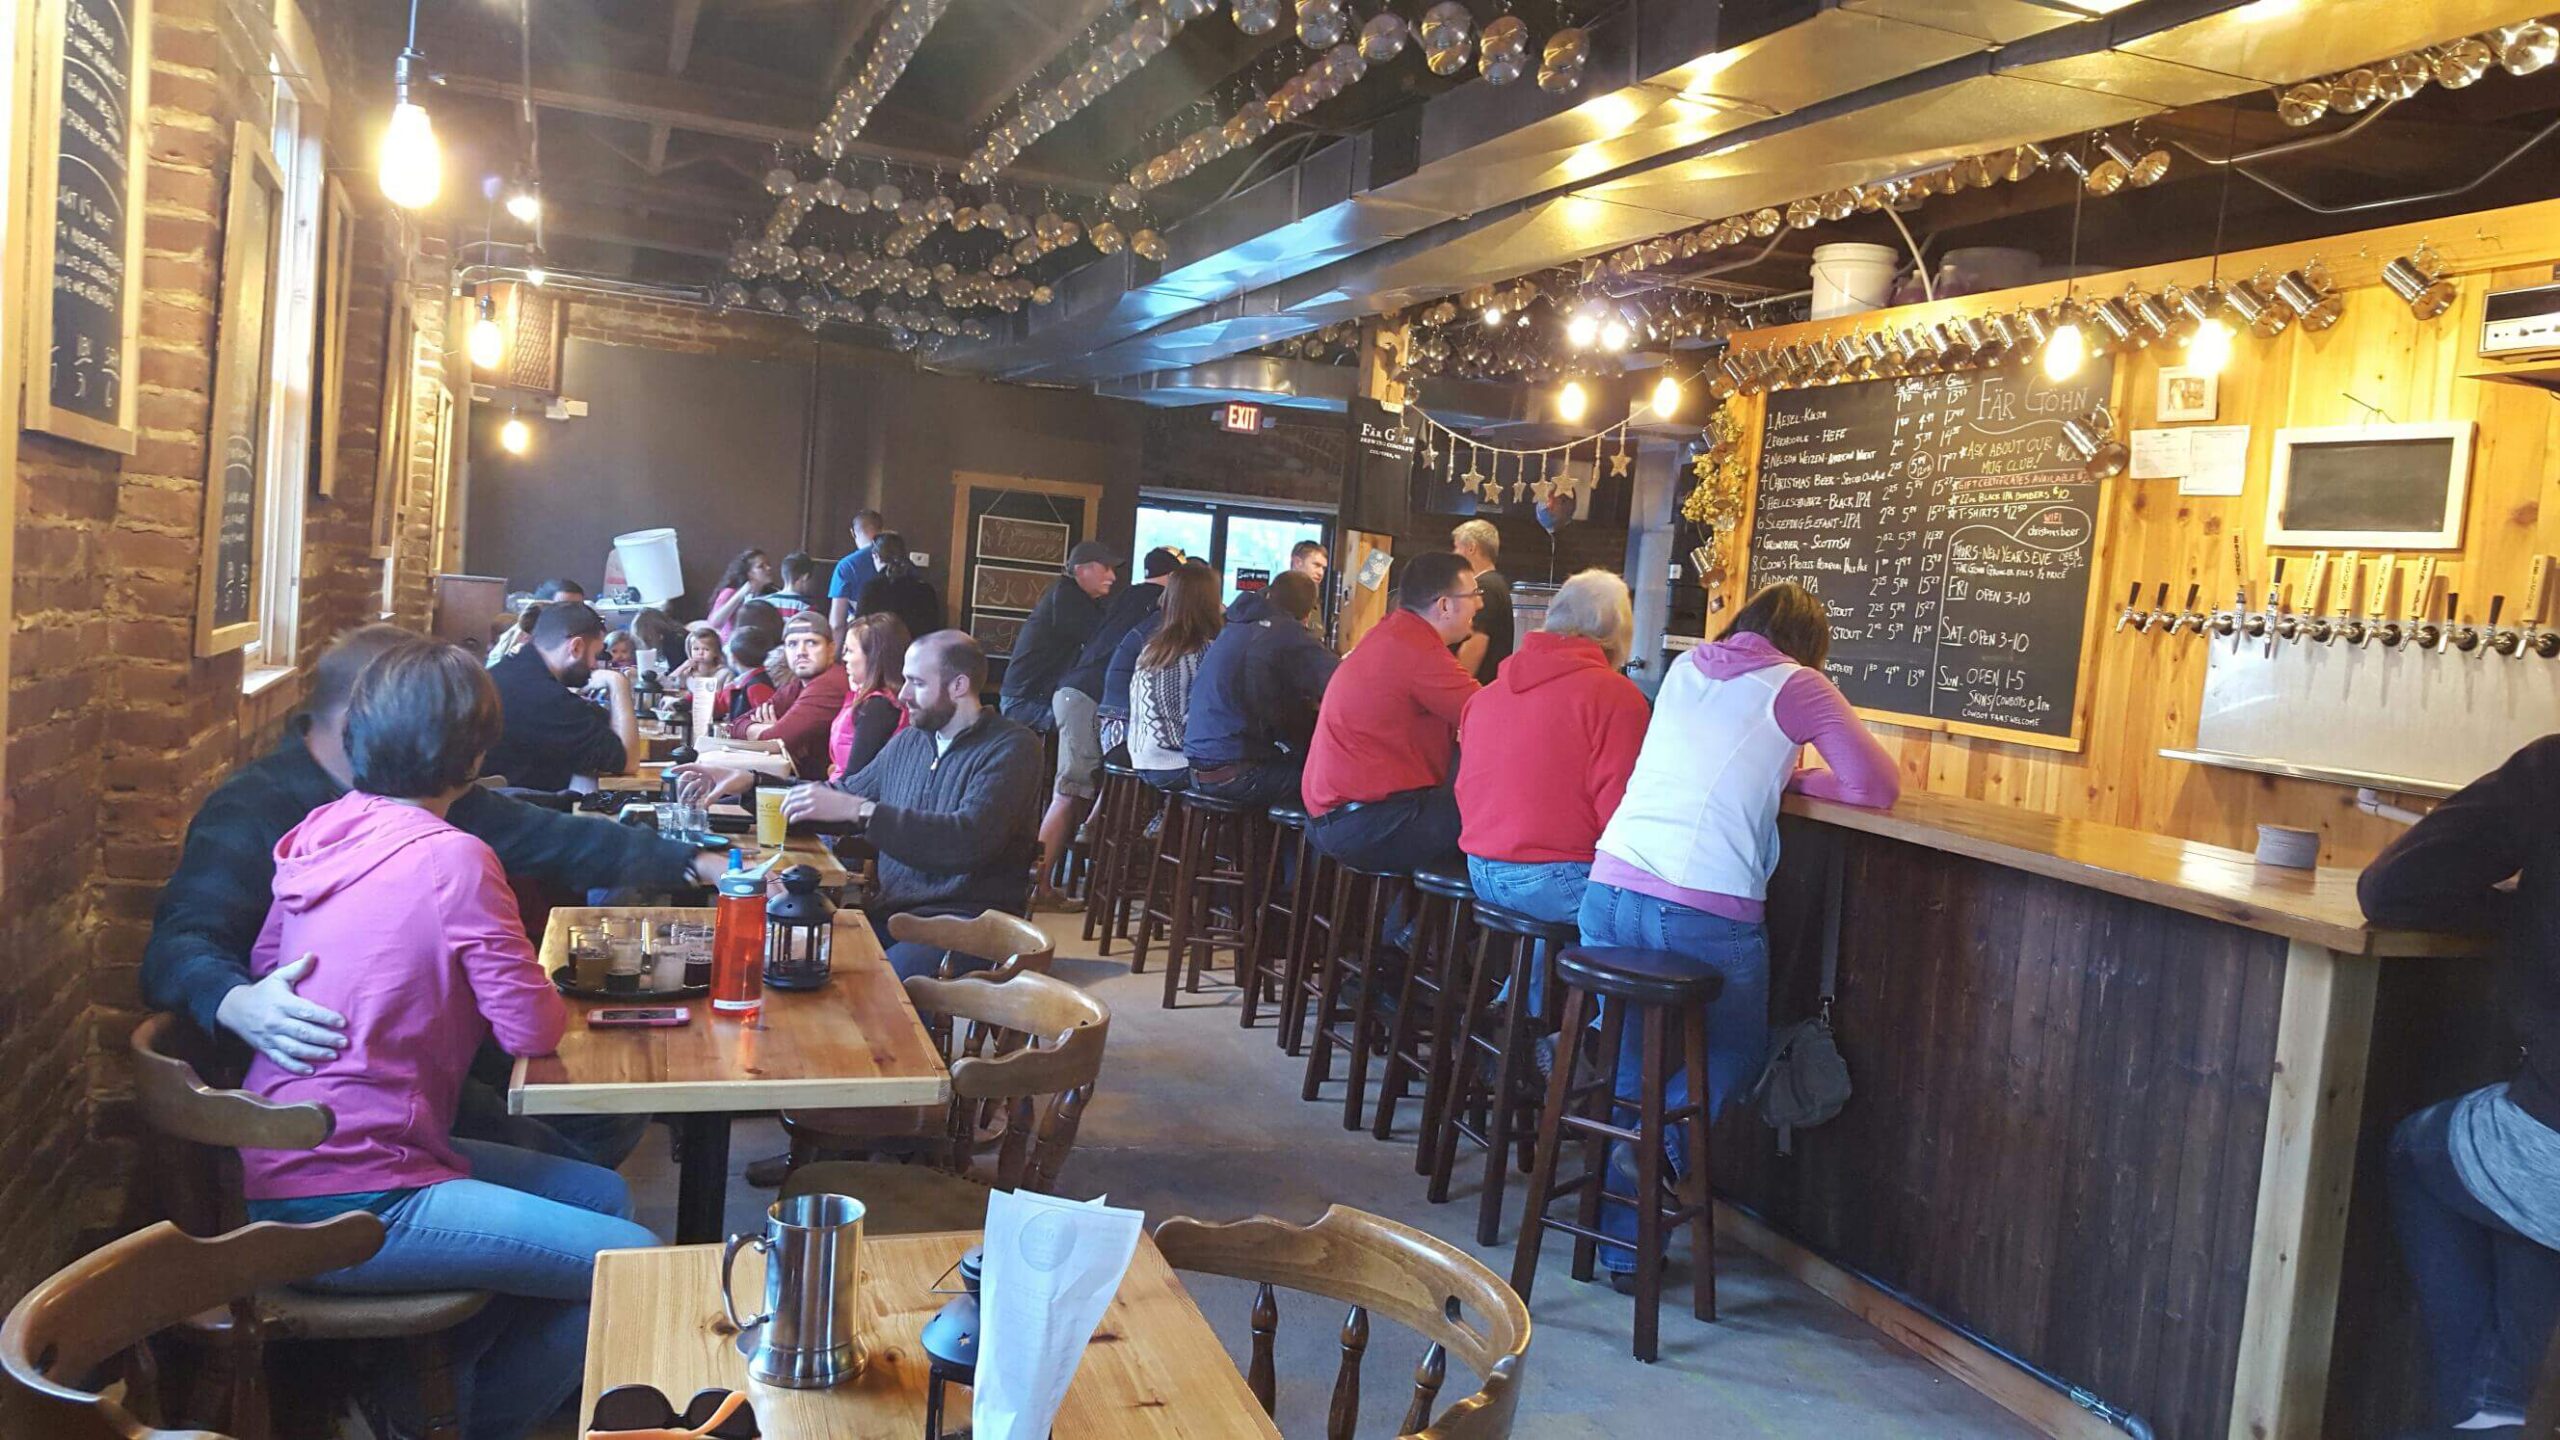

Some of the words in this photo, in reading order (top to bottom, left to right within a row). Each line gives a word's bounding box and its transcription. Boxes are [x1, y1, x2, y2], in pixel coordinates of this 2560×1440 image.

[1976, 377, 2016, 421] FÄR
[2025, 375, 2089, 415] GÖHN
[1228, 404, 1258, 430] EXIT
[1989, 438, 2025, 457] ABOUT
[2027, 436, 2053, 453] OUR
[2006, 453, 2043, 473] CLUB!
[1769, 473, 1811, 492] CHRISTMAS
[1829, 493, 1854, 510] BLACK
[1855, 490, 1871, 508] IPA
[1959, 507, 2000, 520] T-SHIRTS
[2032, 552, 2052, 565] EVE
[1803, 575, 1819, 594] IPA
[1947, 576, 1969, 597] FRI
[1975, 588, 2000, 603] OPEN
[2004, 592, 2031, 606] 3-10
[1826, 600, 1854, 617] STOUT
[1832, 626, 1862, 640] STOUT
[1969, 629, 1996, 646] OPEN
[1998, 632, 2030, 652] 3-10
[1966, 668, 2000, 687] OPEN
[2005, 669, 2026, 691] 1-5
[1962, 708, 1988, 720] COWBOY
